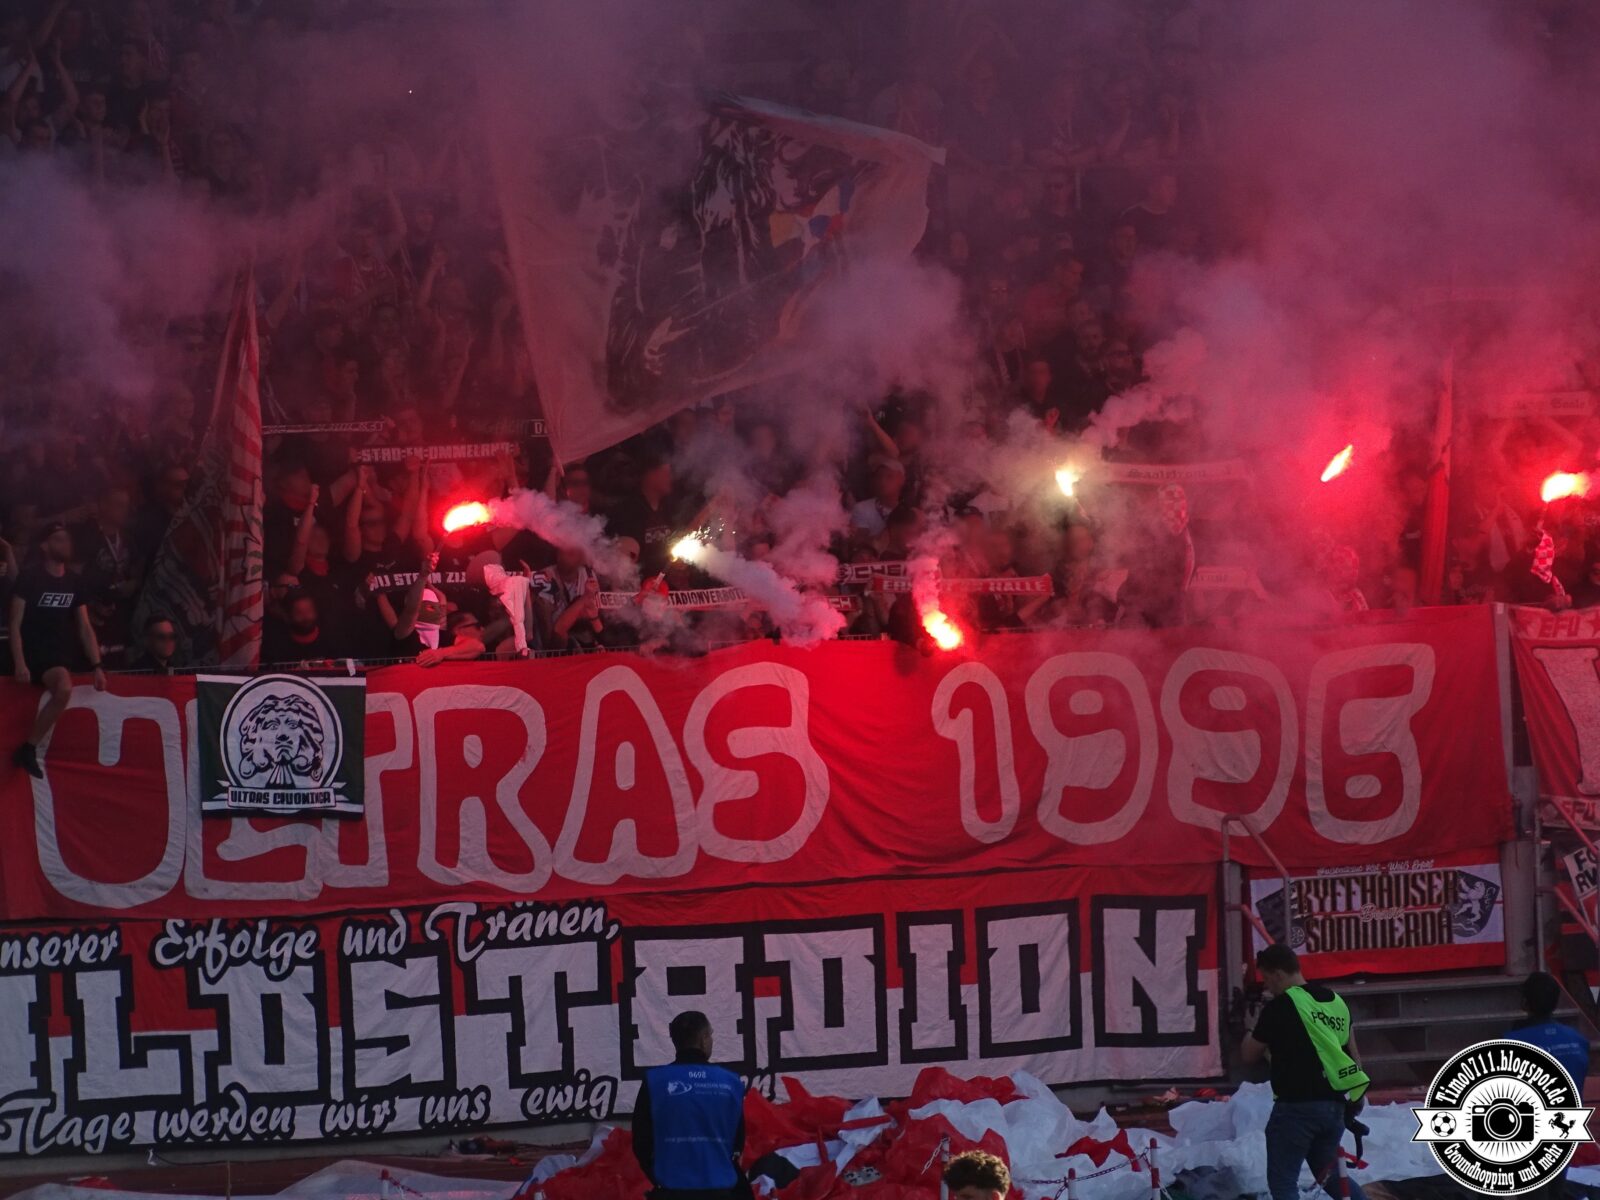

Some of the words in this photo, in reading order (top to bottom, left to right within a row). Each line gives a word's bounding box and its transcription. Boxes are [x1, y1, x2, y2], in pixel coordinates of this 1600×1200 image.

[1538, 615, 1581, 638] EFU
[931, 642, 1436, 846] 1996
[231, 790, 270, 804] ULTRAS
[154, 918, 318, 980] Erfolge
[343, 908, 409, 957] und
[426, 900, 620, 964] Tränen,
[157, 1088, 293, 1139] werden
[325, 1094, 391, 1133] wir
[421, 1086, 487, 1126] uns
[526, 1071, 613, 1119] ewig
